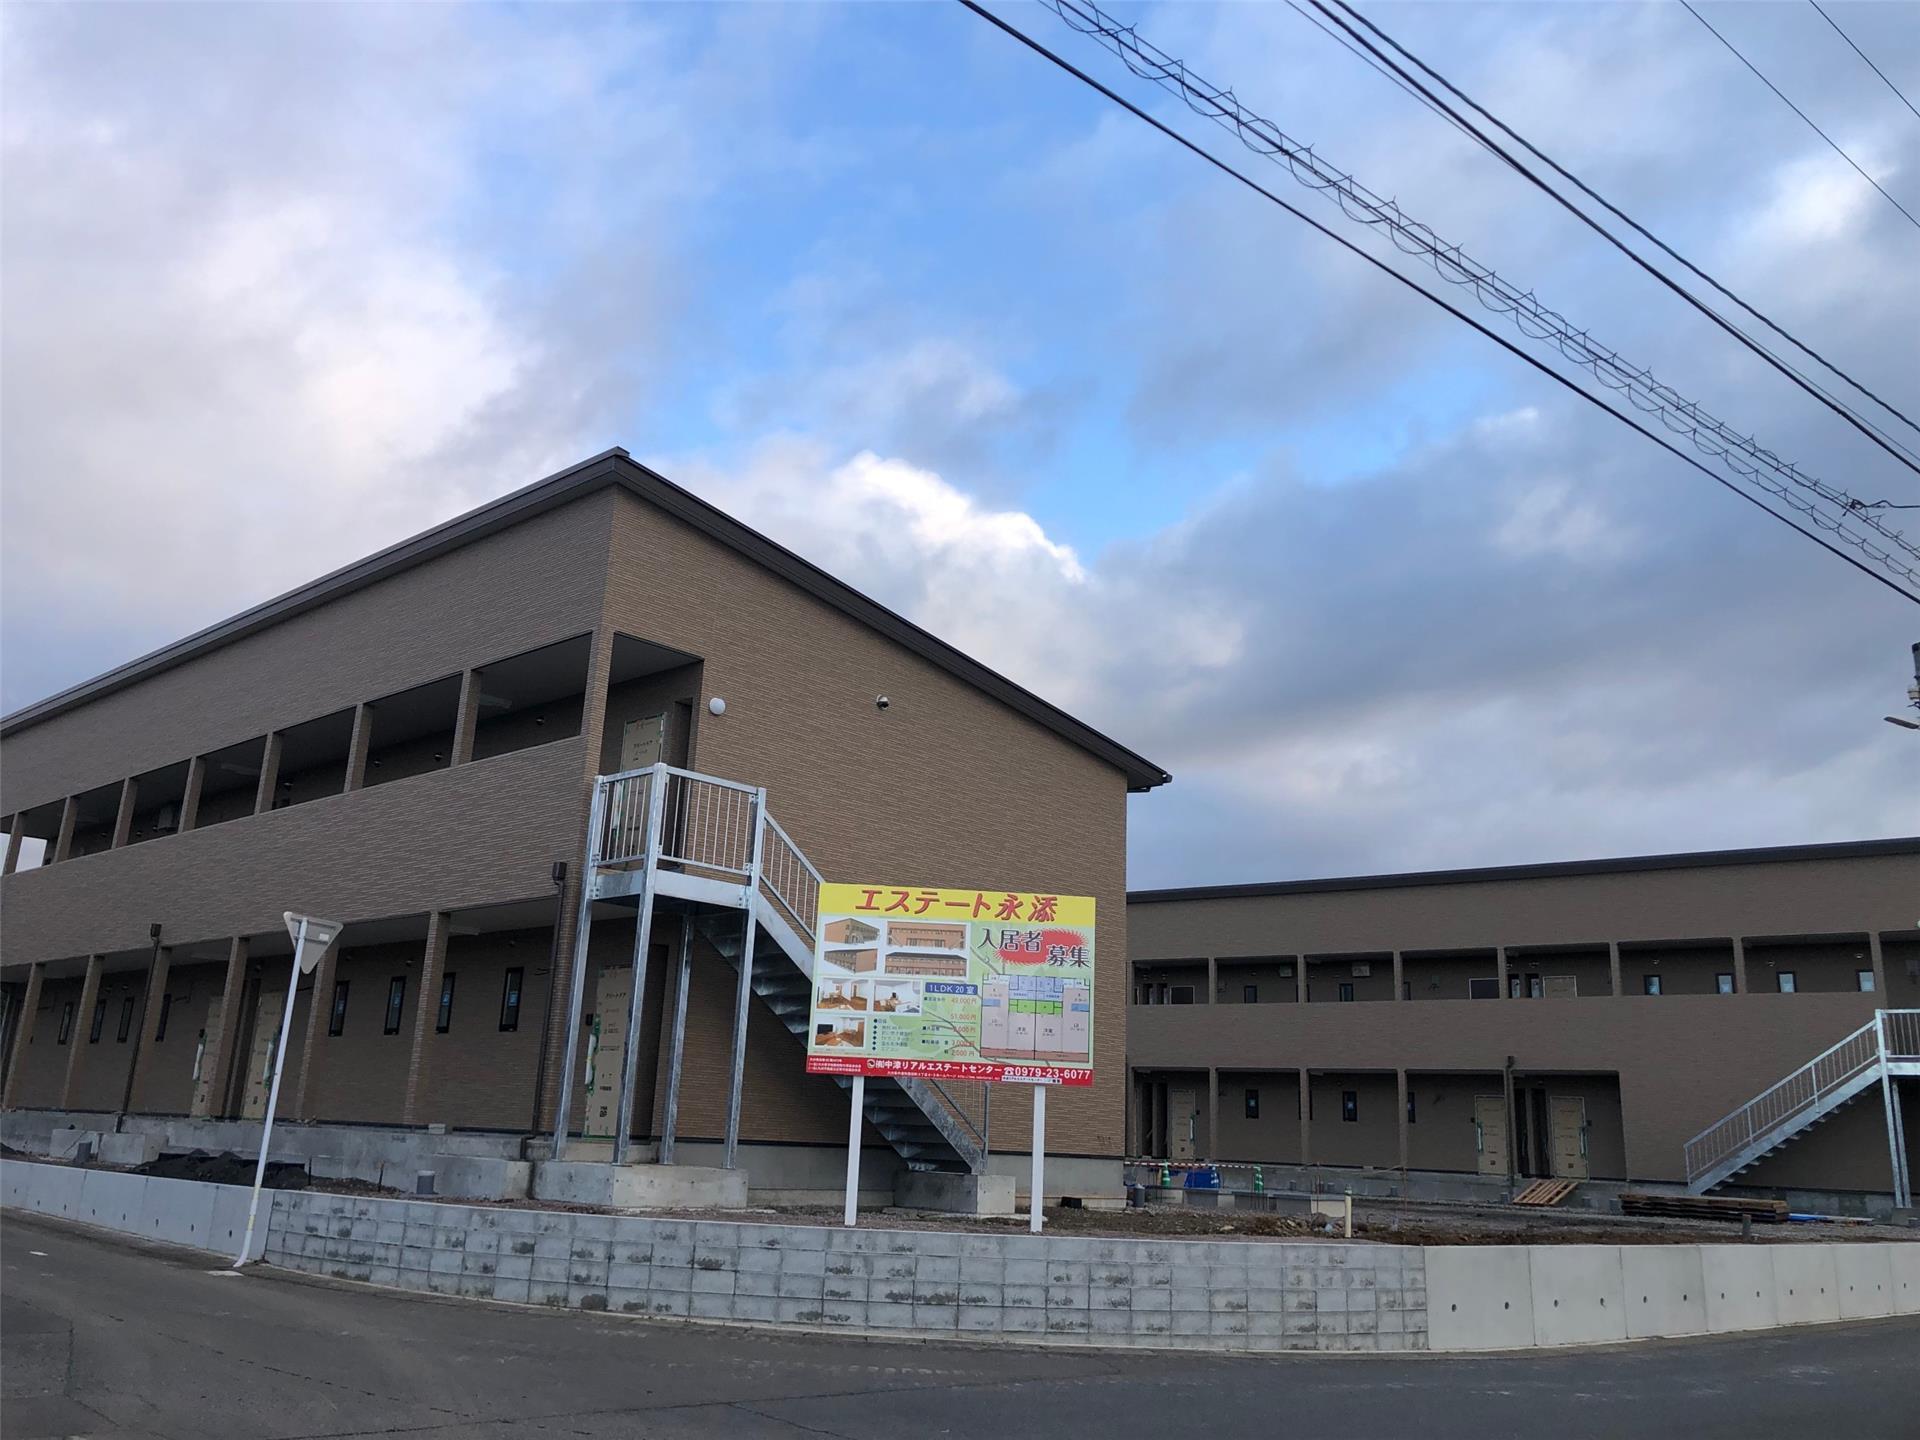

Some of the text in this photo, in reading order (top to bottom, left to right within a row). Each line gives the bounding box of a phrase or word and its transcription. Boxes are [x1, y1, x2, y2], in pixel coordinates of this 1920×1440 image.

[855, 889, 1058, 923] エステート永添
[976, 928, 1044, 952] 入居者
[1046, 945, 1091, 969] 募集
[1014, 1066, 1091, 1080] 0979-23-6077
